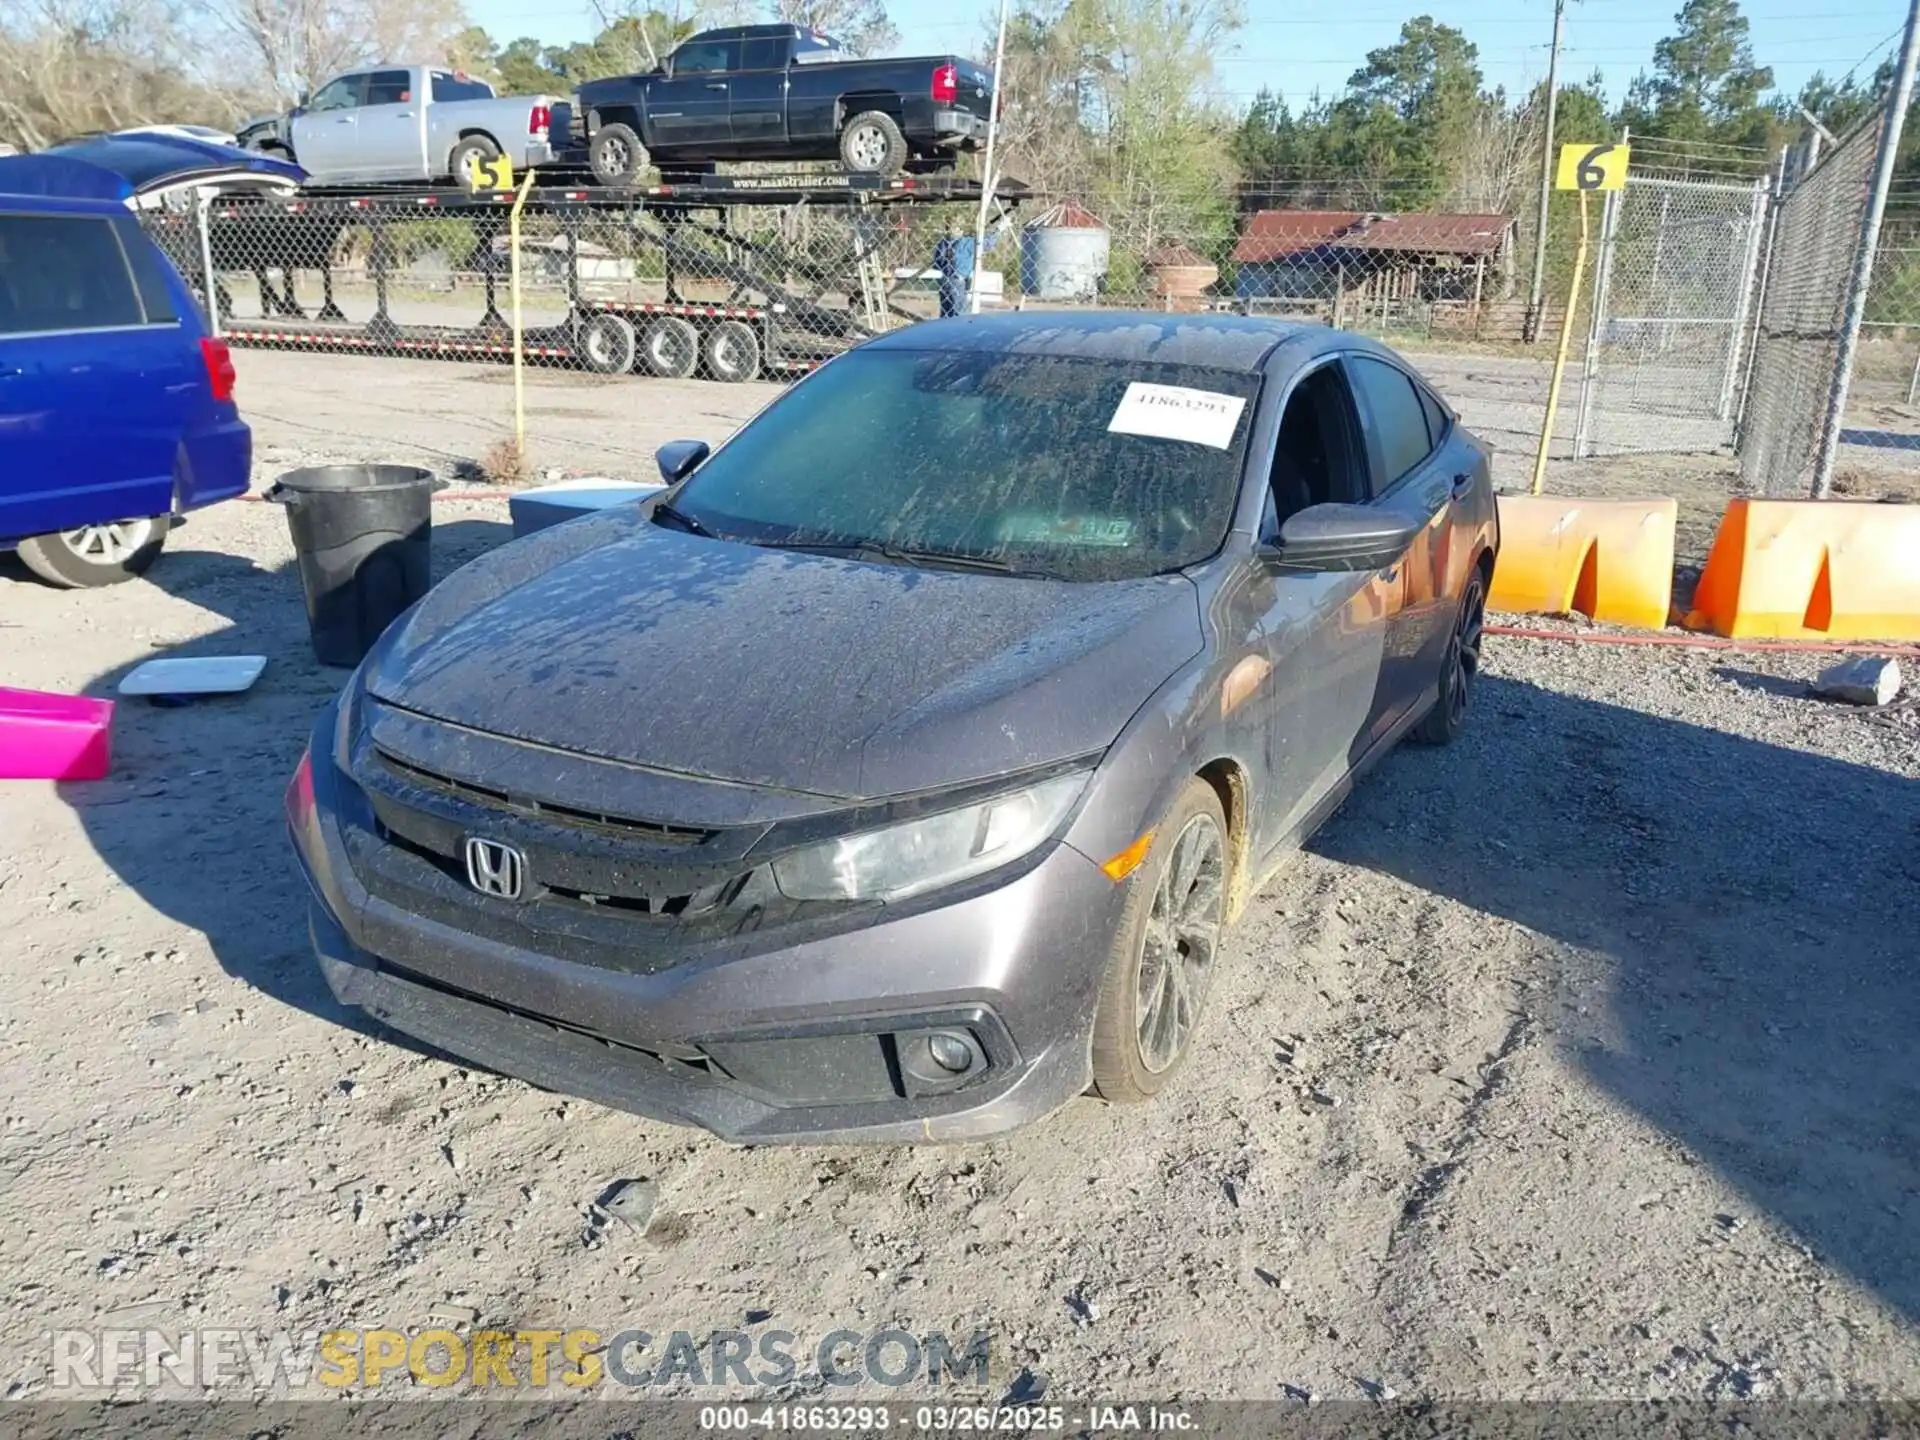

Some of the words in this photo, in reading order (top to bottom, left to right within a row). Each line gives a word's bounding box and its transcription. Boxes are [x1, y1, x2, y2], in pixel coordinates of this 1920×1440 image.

[478, 155, 499, 188] 5
[1577, 143, 1615, 189] 6
[1137, 393, 1228, 414] 41863293
